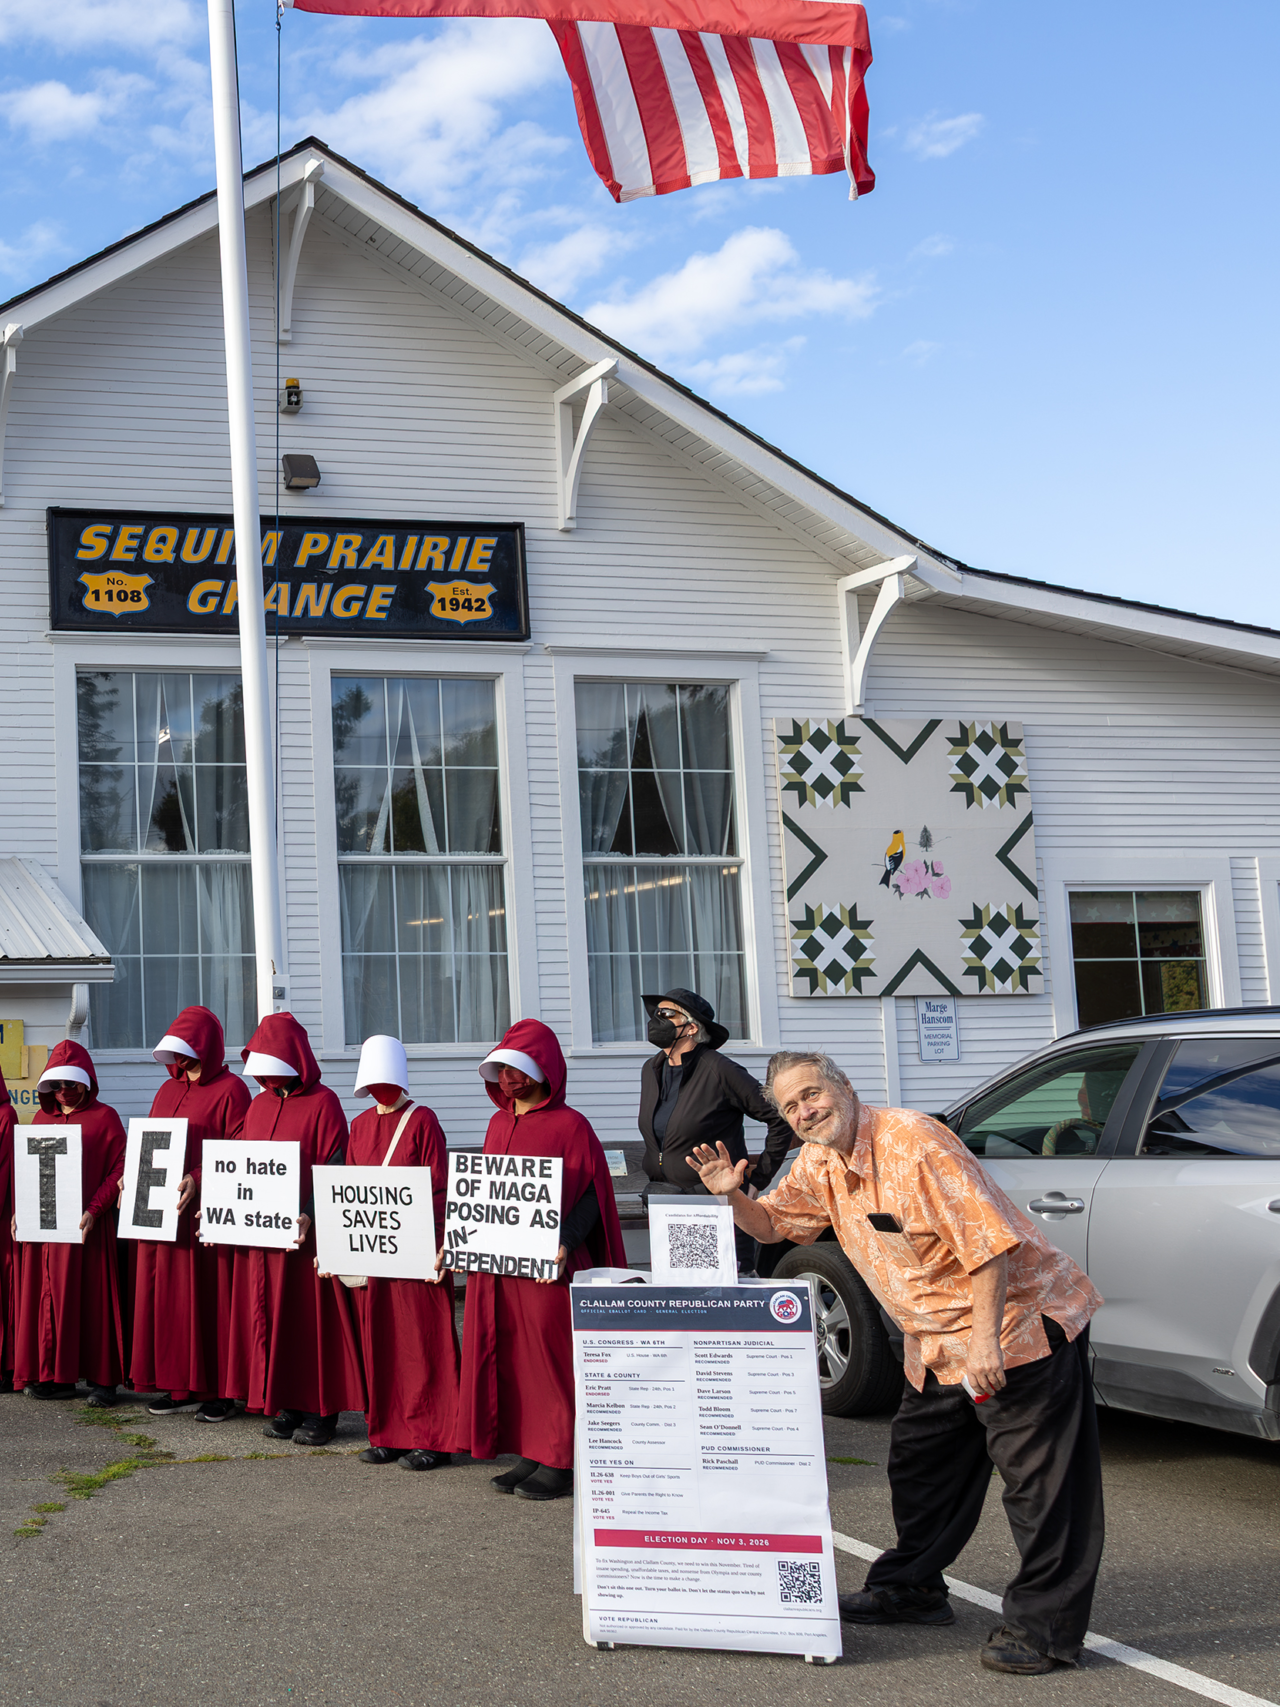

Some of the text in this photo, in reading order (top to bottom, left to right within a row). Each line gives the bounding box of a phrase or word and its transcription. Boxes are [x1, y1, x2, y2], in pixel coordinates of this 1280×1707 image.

[294, 532, 499, 572] PRAIRIE
[106, 577, 127, 586] No.
[453, 587, 472, 596] Est.
[91, 589, 142, 603] 1108
[437, 597, 486, 612] 1942
[921, 1013, 953, 1024] Hanscom
[925, 1002, 947, 1014] Marge
[215, 1157, 287, 1176] no hate
[455, 1155, 552, 1178] BEWARE
[27, 1136, 67, 1229] T
[132, 1131, 172, 1228] E
[237, 1183, 253, 1200] in
[332, 1185, 413, 1206] HOUSING
[456, 1178, 551, 1204] OF MAGA
[206, 1207, 293, 1229] WA state
[343, 1209, 401, 1230] SAVES
[447, 1201, 559, 1230] POSING AS
[349, 1233, 398, 1254] LIVES
[447, 1226, 477, 1249] IN-
[443, 1249, 557, 1279] DEPENDENT
[669, 1300, 731, 1308] REPUBLICAN
